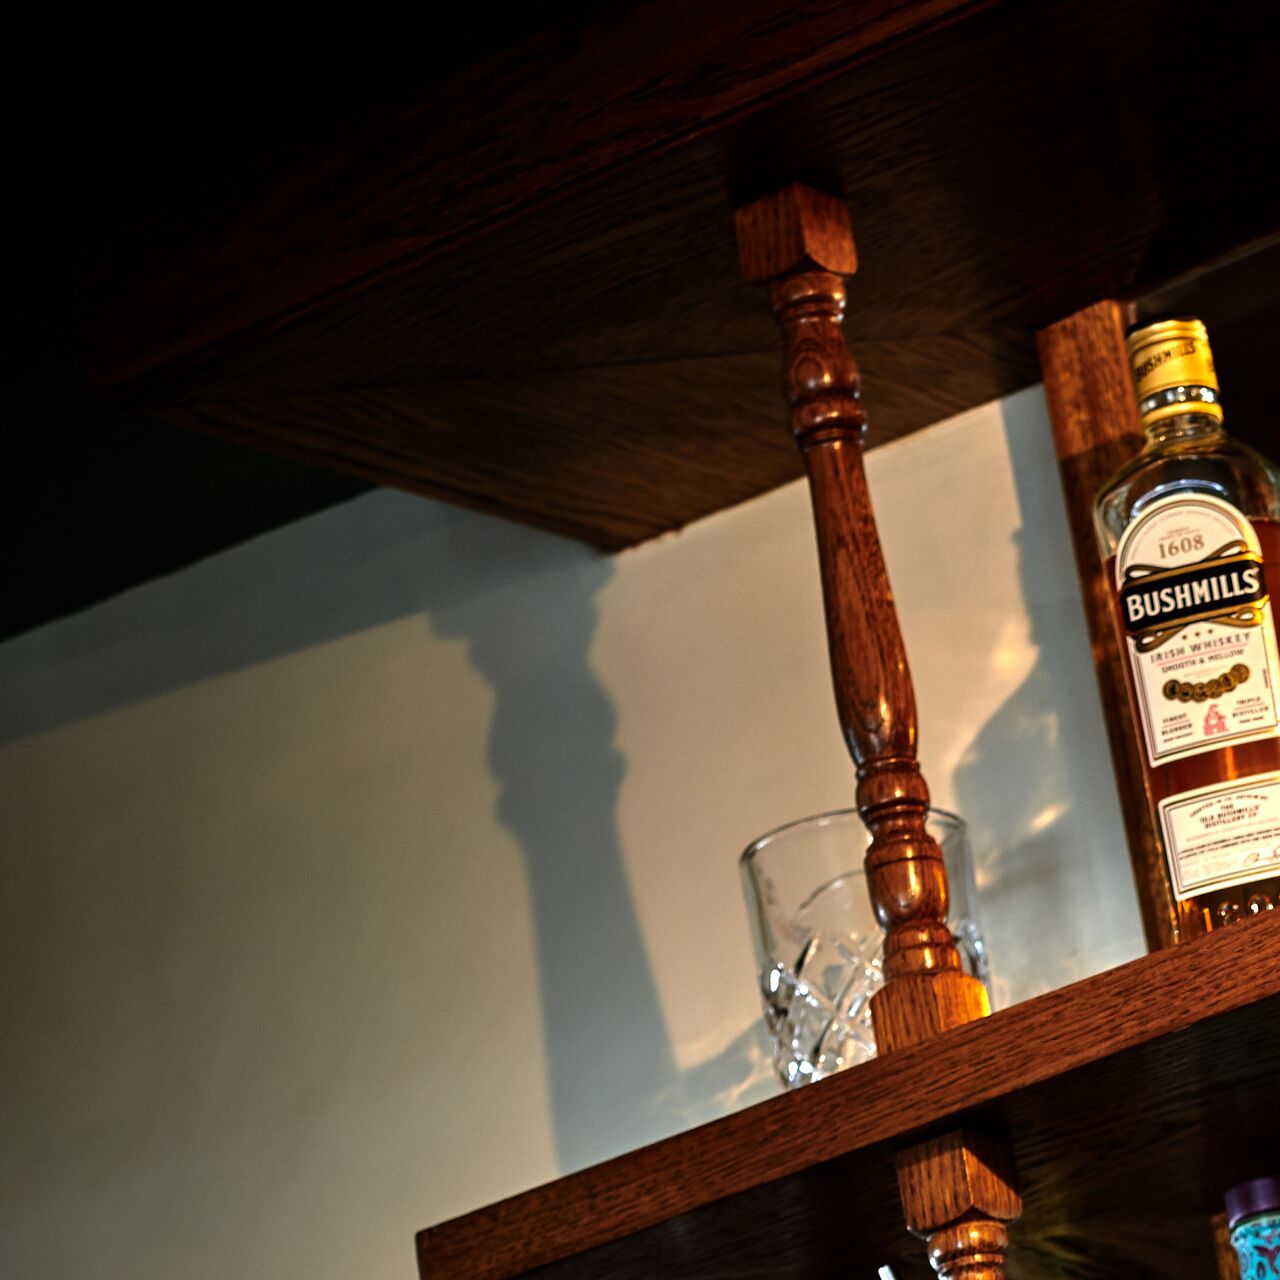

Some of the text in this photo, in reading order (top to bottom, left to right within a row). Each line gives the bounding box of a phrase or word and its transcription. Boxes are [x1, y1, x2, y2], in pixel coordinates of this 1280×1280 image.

[1159, 534, 1205, 559] 1608
[1126, 568, 1260, 623] BUSHMILLS
[1150, 645, 1186, 664] IRISH
[1190, 632, 1250, 652] WHISKEY
